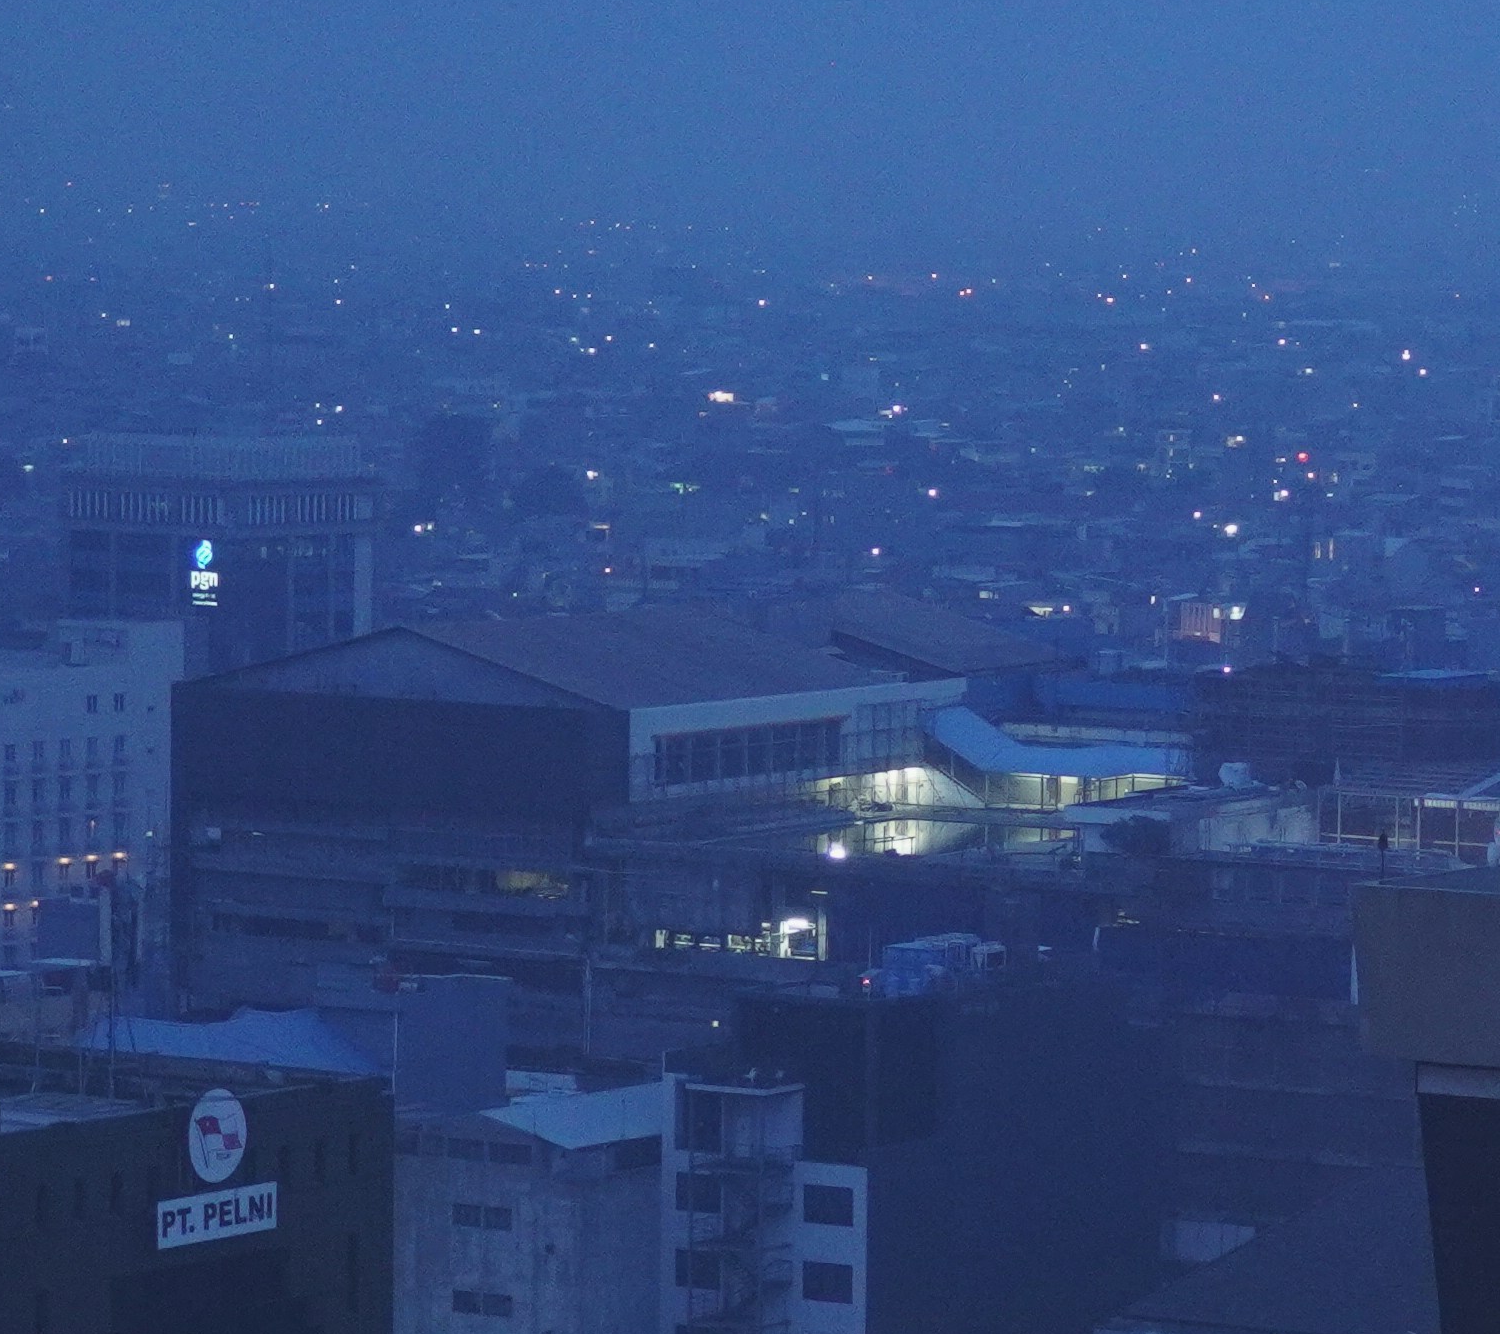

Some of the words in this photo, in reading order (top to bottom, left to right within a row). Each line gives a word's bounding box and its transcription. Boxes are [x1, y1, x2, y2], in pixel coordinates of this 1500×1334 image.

[190, 570, 218, 590] pgn
[162, 1207, 195, 1238] PT.
[204, 1192, 273, 1230] PELNI
